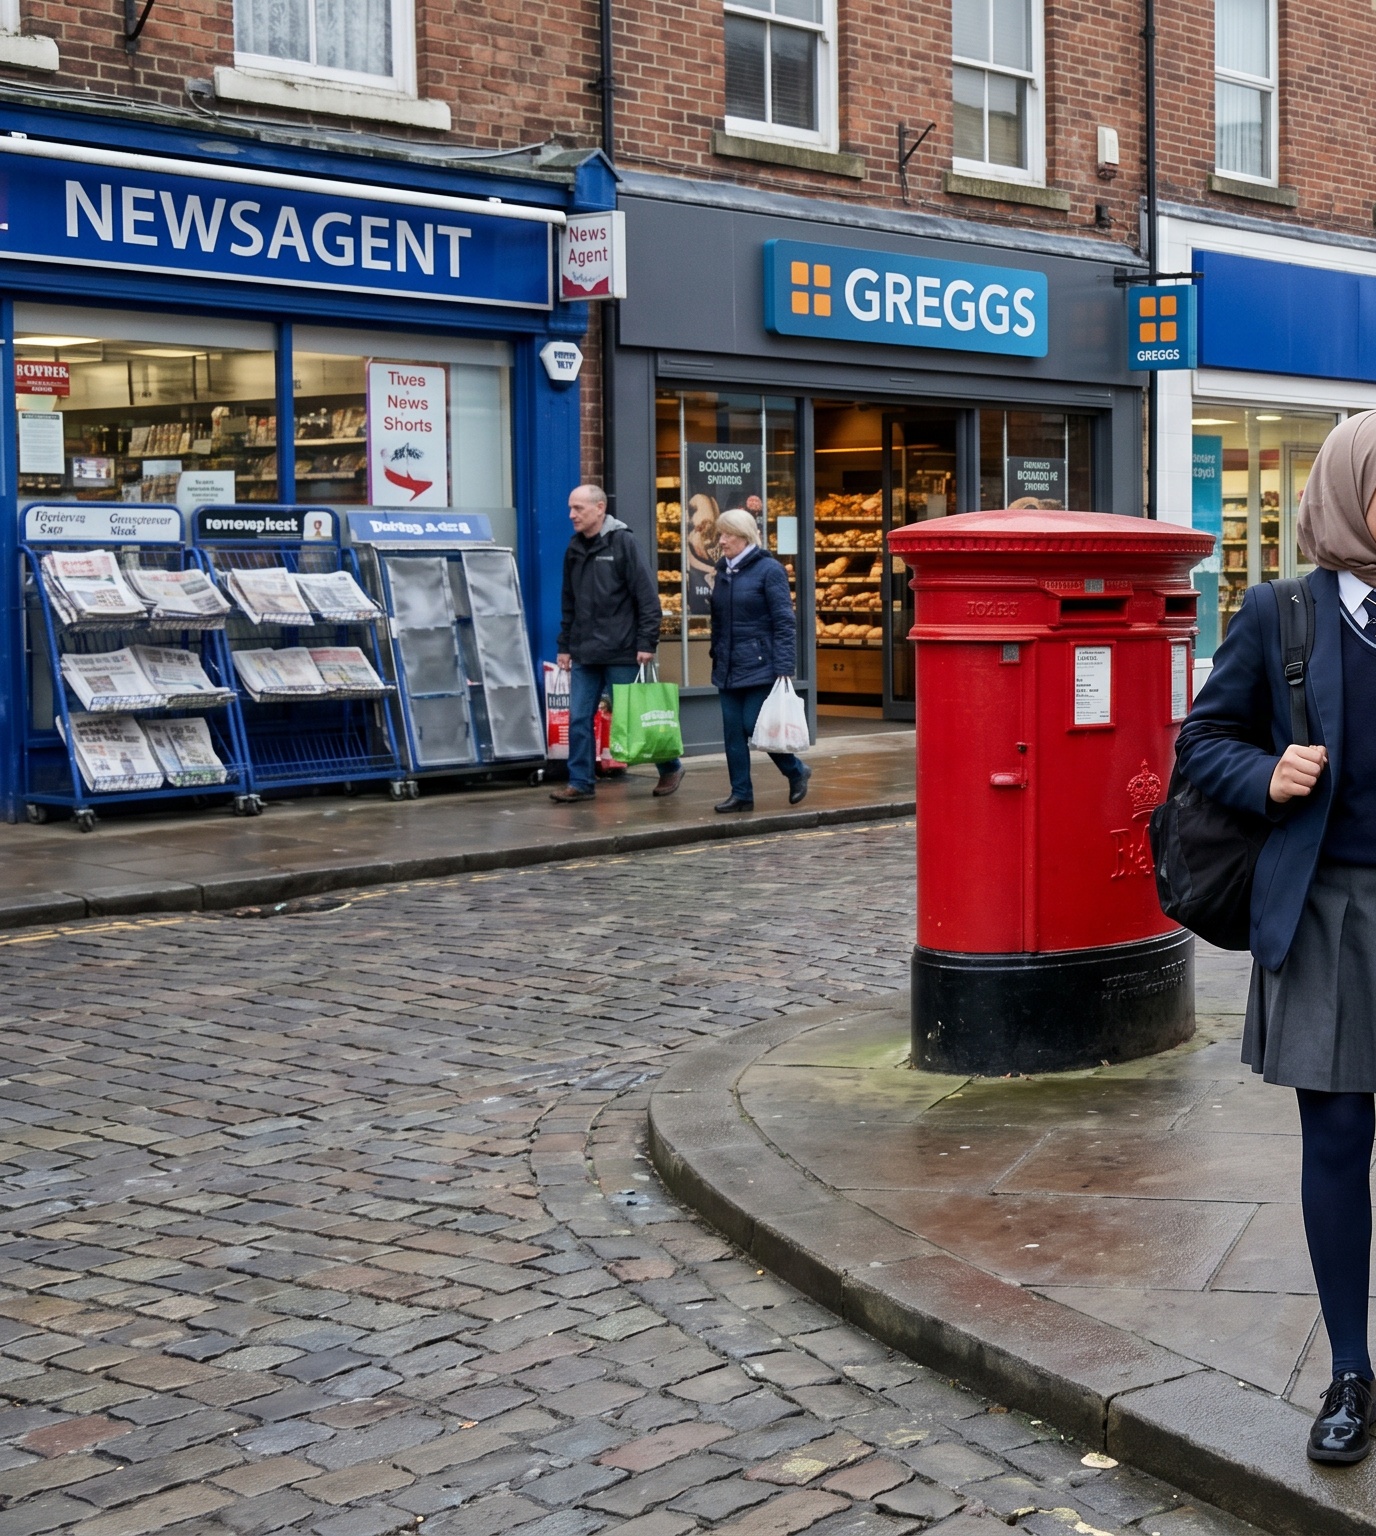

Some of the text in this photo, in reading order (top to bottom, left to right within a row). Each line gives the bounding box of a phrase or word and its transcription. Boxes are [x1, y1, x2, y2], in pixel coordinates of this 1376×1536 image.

[65, 179, 472, 279] NEWSAGENT
[569, 226, 607, 243] News
[568, 247, 608, 267] Agent
[844, 267, 1036, 338] GREGGS
[1137, 349, 1180, 361] GREGGS
[387, 371, 426, 387] Tives
[387, 395, 429, 410] News
[383, 416, 433, 433] Shorts
